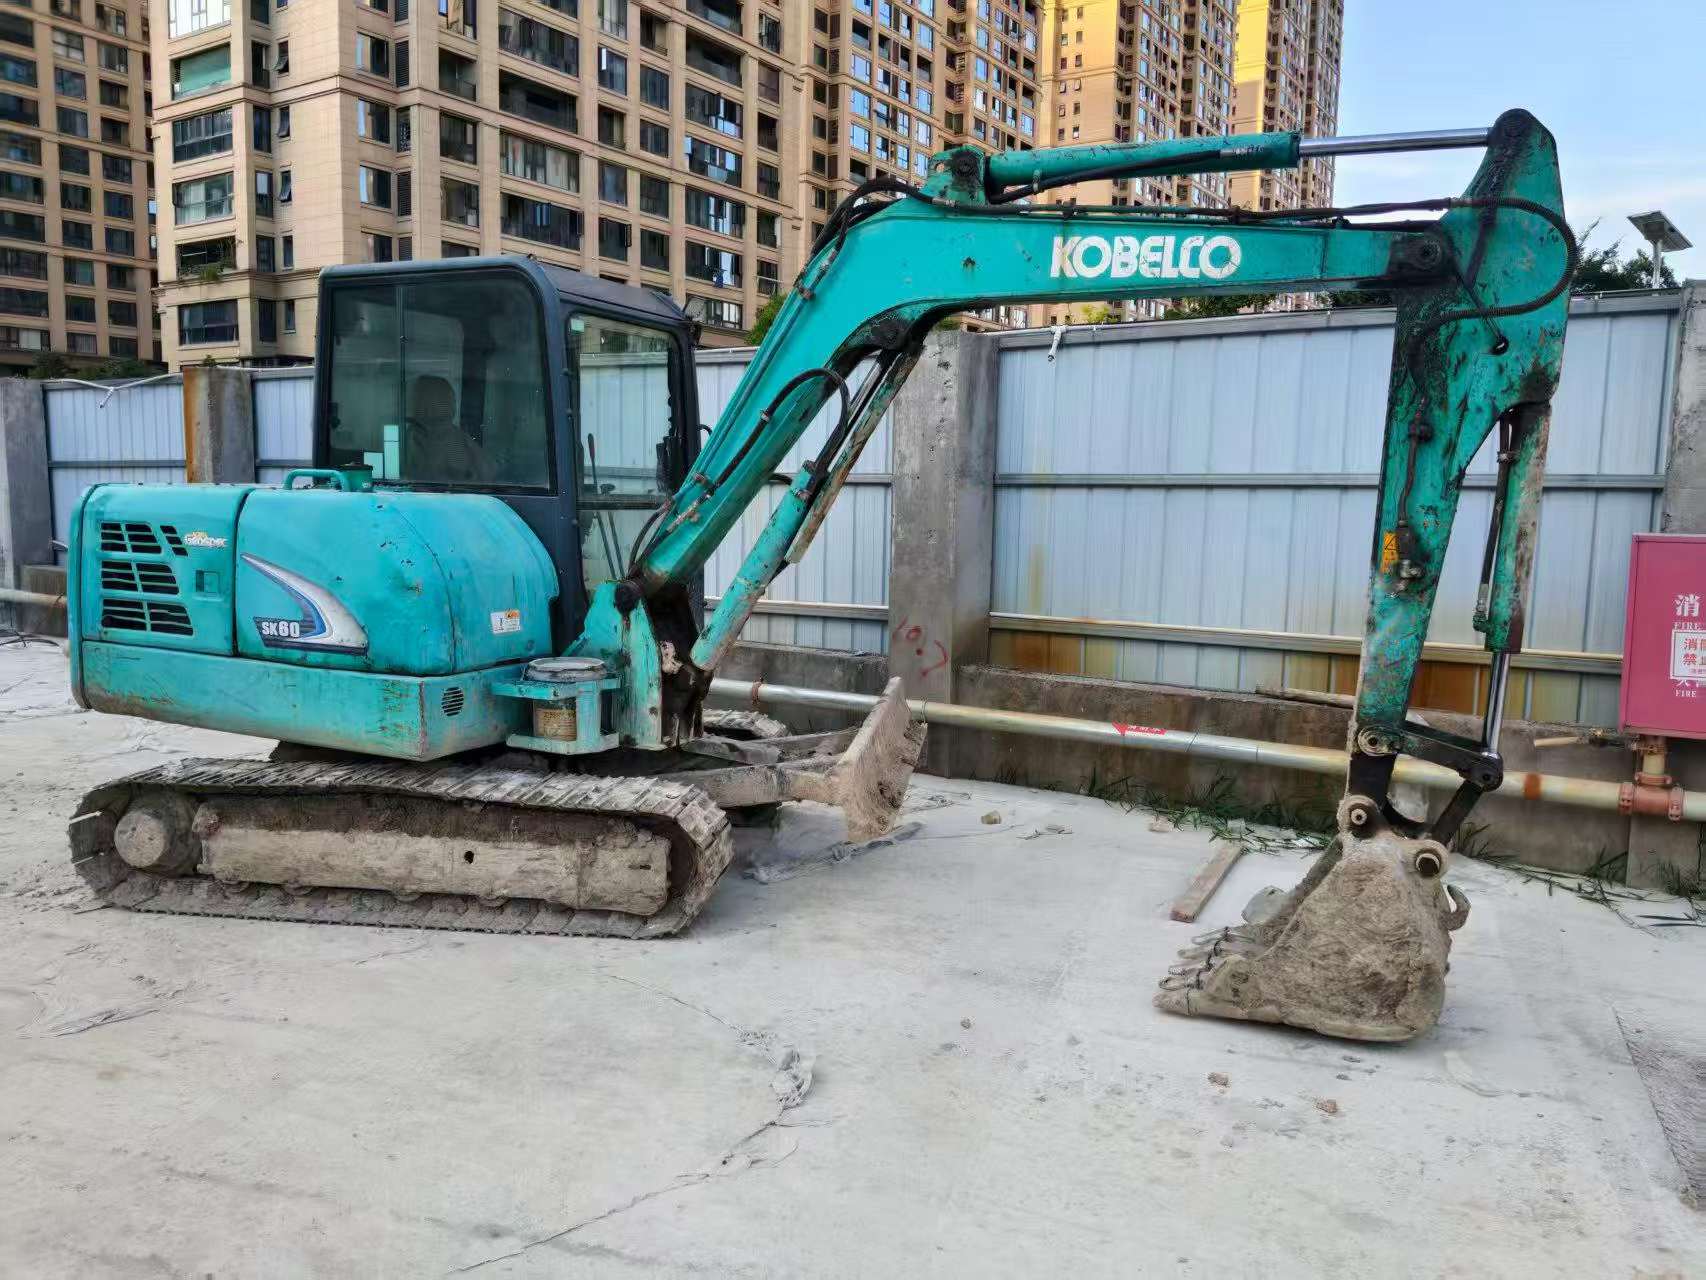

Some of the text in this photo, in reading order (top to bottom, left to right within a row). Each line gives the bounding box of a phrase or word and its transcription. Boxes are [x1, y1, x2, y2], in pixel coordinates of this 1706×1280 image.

[1050, 235, 1242, 279] KOBELCO
[1674, 594, 1700, 617] 消
[261, 620, 300, 638] SK60
[1675, 689, 1697, 698] FIRE
